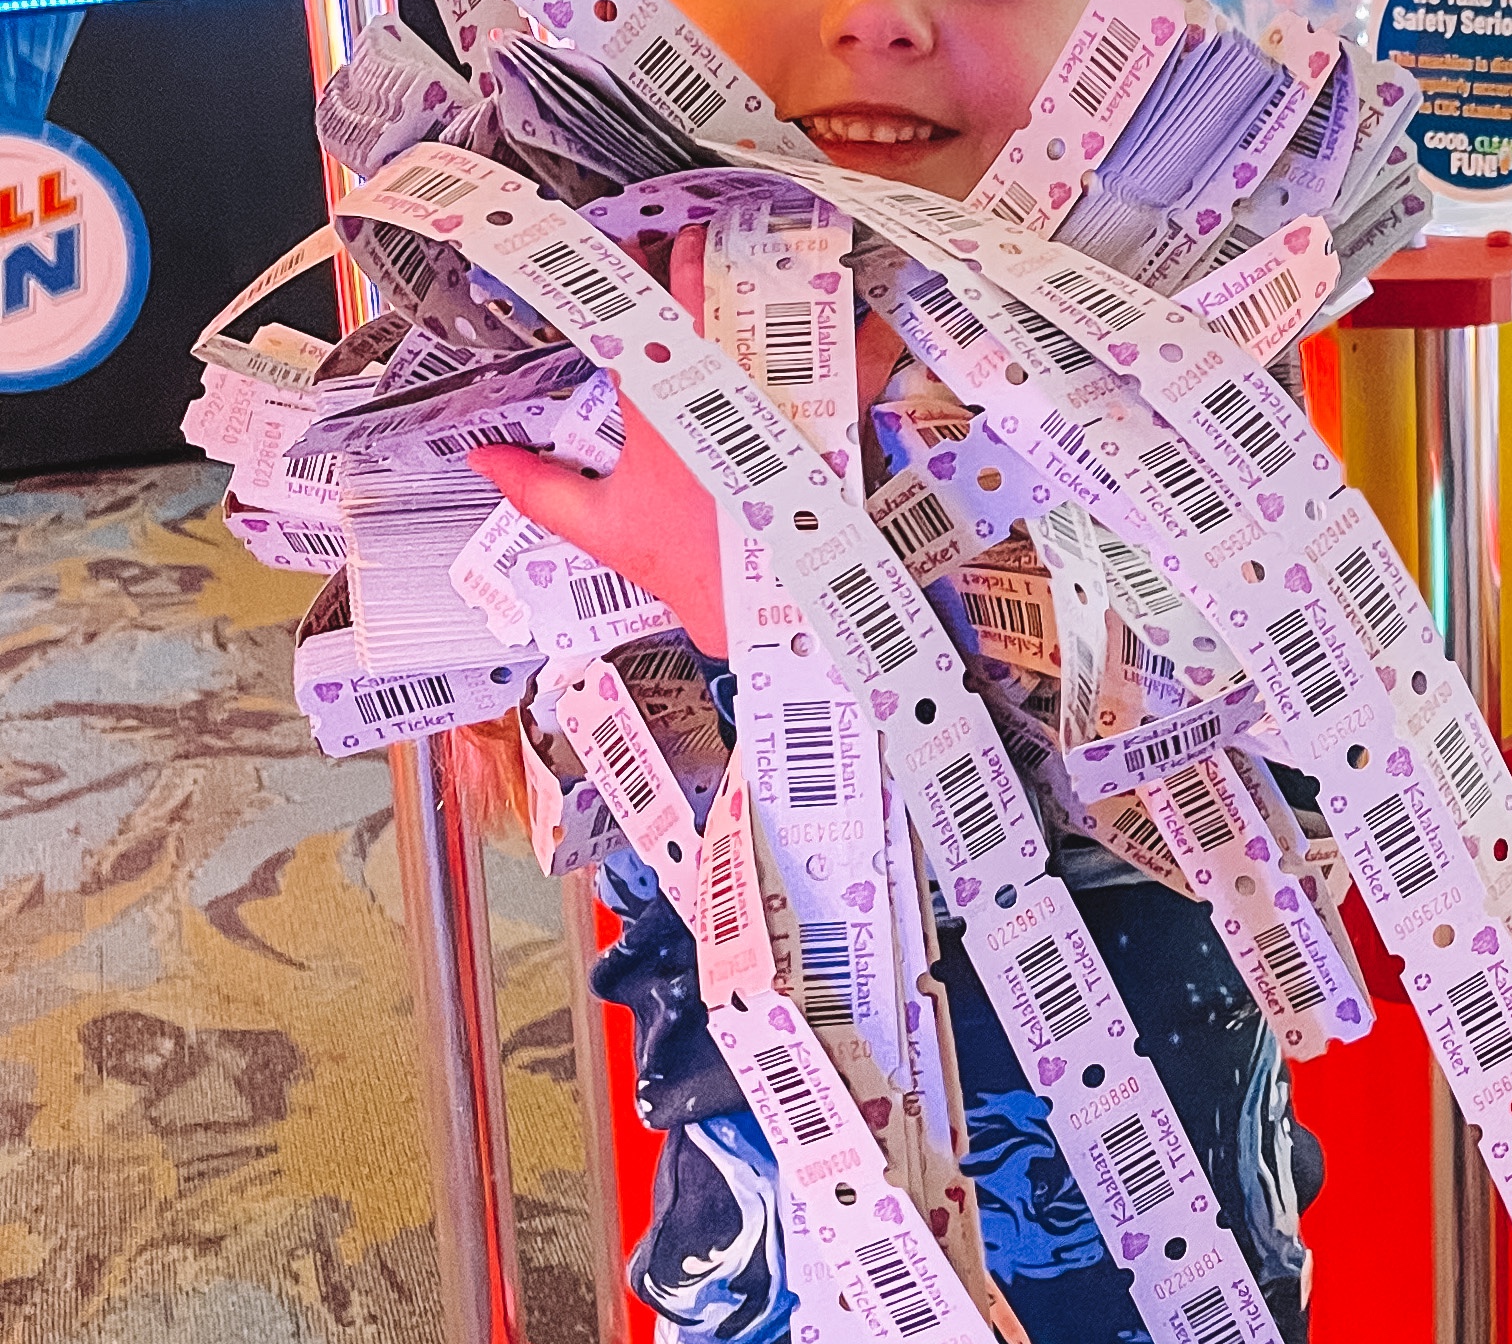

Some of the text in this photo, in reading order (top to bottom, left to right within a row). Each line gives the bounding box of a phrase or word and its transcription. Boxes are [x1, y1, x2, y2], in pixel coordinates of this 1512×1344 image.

[673, 22, 738, 90] 1 Ticket
[1058, 10, 1106, 85] 1 Ticket
[1393, 6, 1457, 39] Safety
[1100, 44, 1155, 127] Kalahari
[1252, 78, 1309, 157] Kalahari
[518, 263, 596, 331] Kalahari
[579, 234, 653, 297] 1 Ticket
[1197, 252, 1288, 317] Kalahari
[814, 301, 839, 379] Kalahari
[888, 302, 950, 362] 1 Ticket
[988, 311, 1051, 375] 1 Ticket
[1033, 285, 1112, 342] Kalahari
[1252, 308, 1304, 357] Ticket
[734, 385, 805, 457] 1 Ticket
[1242, 372, 1307, 444] 1 Ticket
[676, 413, 751, 496] Kalahari
[1026, 440, 1102, 506] 1 Ticket
[1191, 410, 1262, 490] Kalahari
[1124, 468, 1188, 540] 1 Ticket
[590, 606, 674, 642] 1 Ticket
[820, 591, 882, 684] Kalahari
[1304, 597, 1361, 688] Kalahari
[1248, 641, 1302, 724] 1 Ticket
[376, 710, 456, 741] 1 Ticket
[612, 706, 662, 791] Kalahari
[753, 712, 778, 806] 1 Ticket
[835, 701, 864, 803] Kalahari
[584, 745, 630, 820] 1 Ticket
[1198, 755, 1250, 833] Kalahari
[924, 782, 969, 873] Kalahari
[1344, 825, 1391, 905] 1 Ticket
[1403, 782, 1456, 874] Kalahari
[986, 895, 1057, 952] 0229879
[1394, 884, 1462, 943] 0229506
[850, 922, 879, 1024] Kalahari
[1291, 917, 1340, 994] Kalahari
[1003, 960, 1052, 1052] Kalahari
[738, 1066, 790, 1146] 1 Ticket
[788, 1040, 850, 1135] Kalahari
[1069, 1075, 1142, 1131] 0229880
[1091, 1139, 1136, 1229] Kalahari
[893, 1231, 952, 1319] Kalahari
[1153, 1247, 1225, 1301] 0229881
[1231, 1278, 1264, 1338] Ticket
